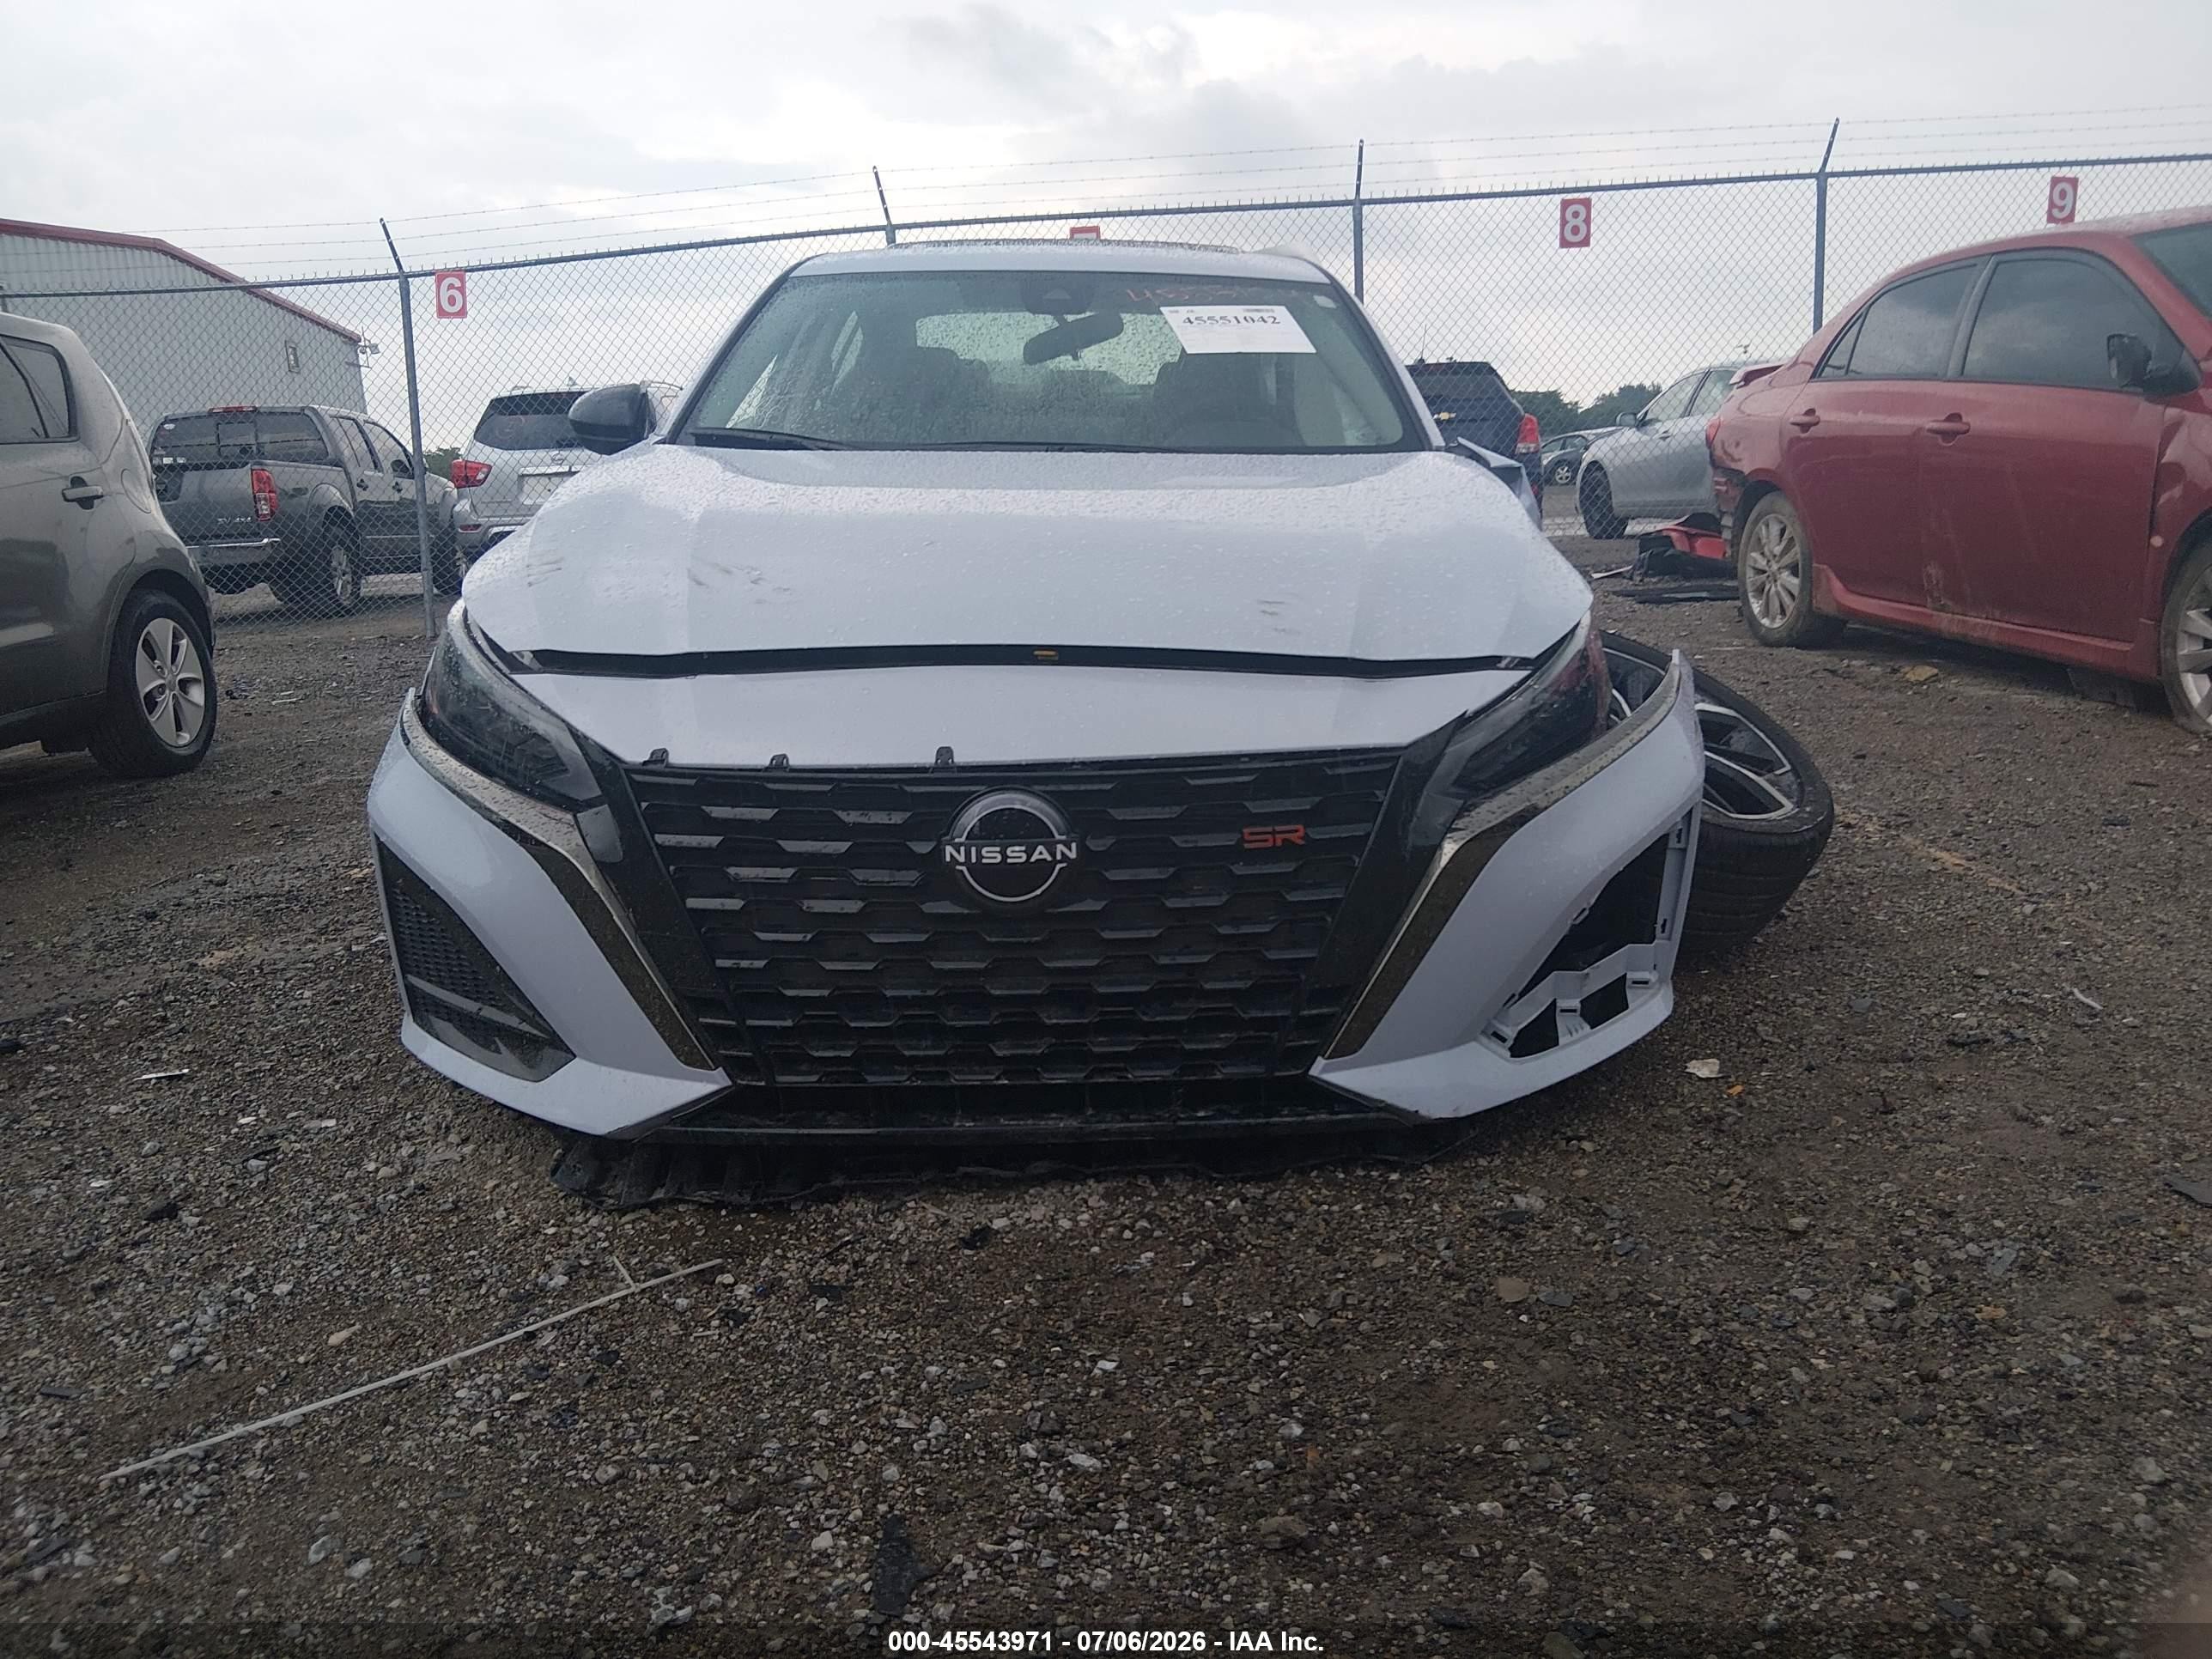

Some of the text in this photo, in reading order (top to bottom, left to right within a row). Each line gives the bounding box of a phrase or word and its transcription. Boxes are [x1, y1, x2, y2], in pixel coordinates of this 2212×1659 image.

[2051, 181, 2074, 219] 9
[1564, 204, 1588, 242] 8
[439, 276, 464, 313] 6
[1182, 315, 1281, 325] 45551042
[1242, 824, 1305, 849] SR
[945, 842, 1078, 864] NISSAN
